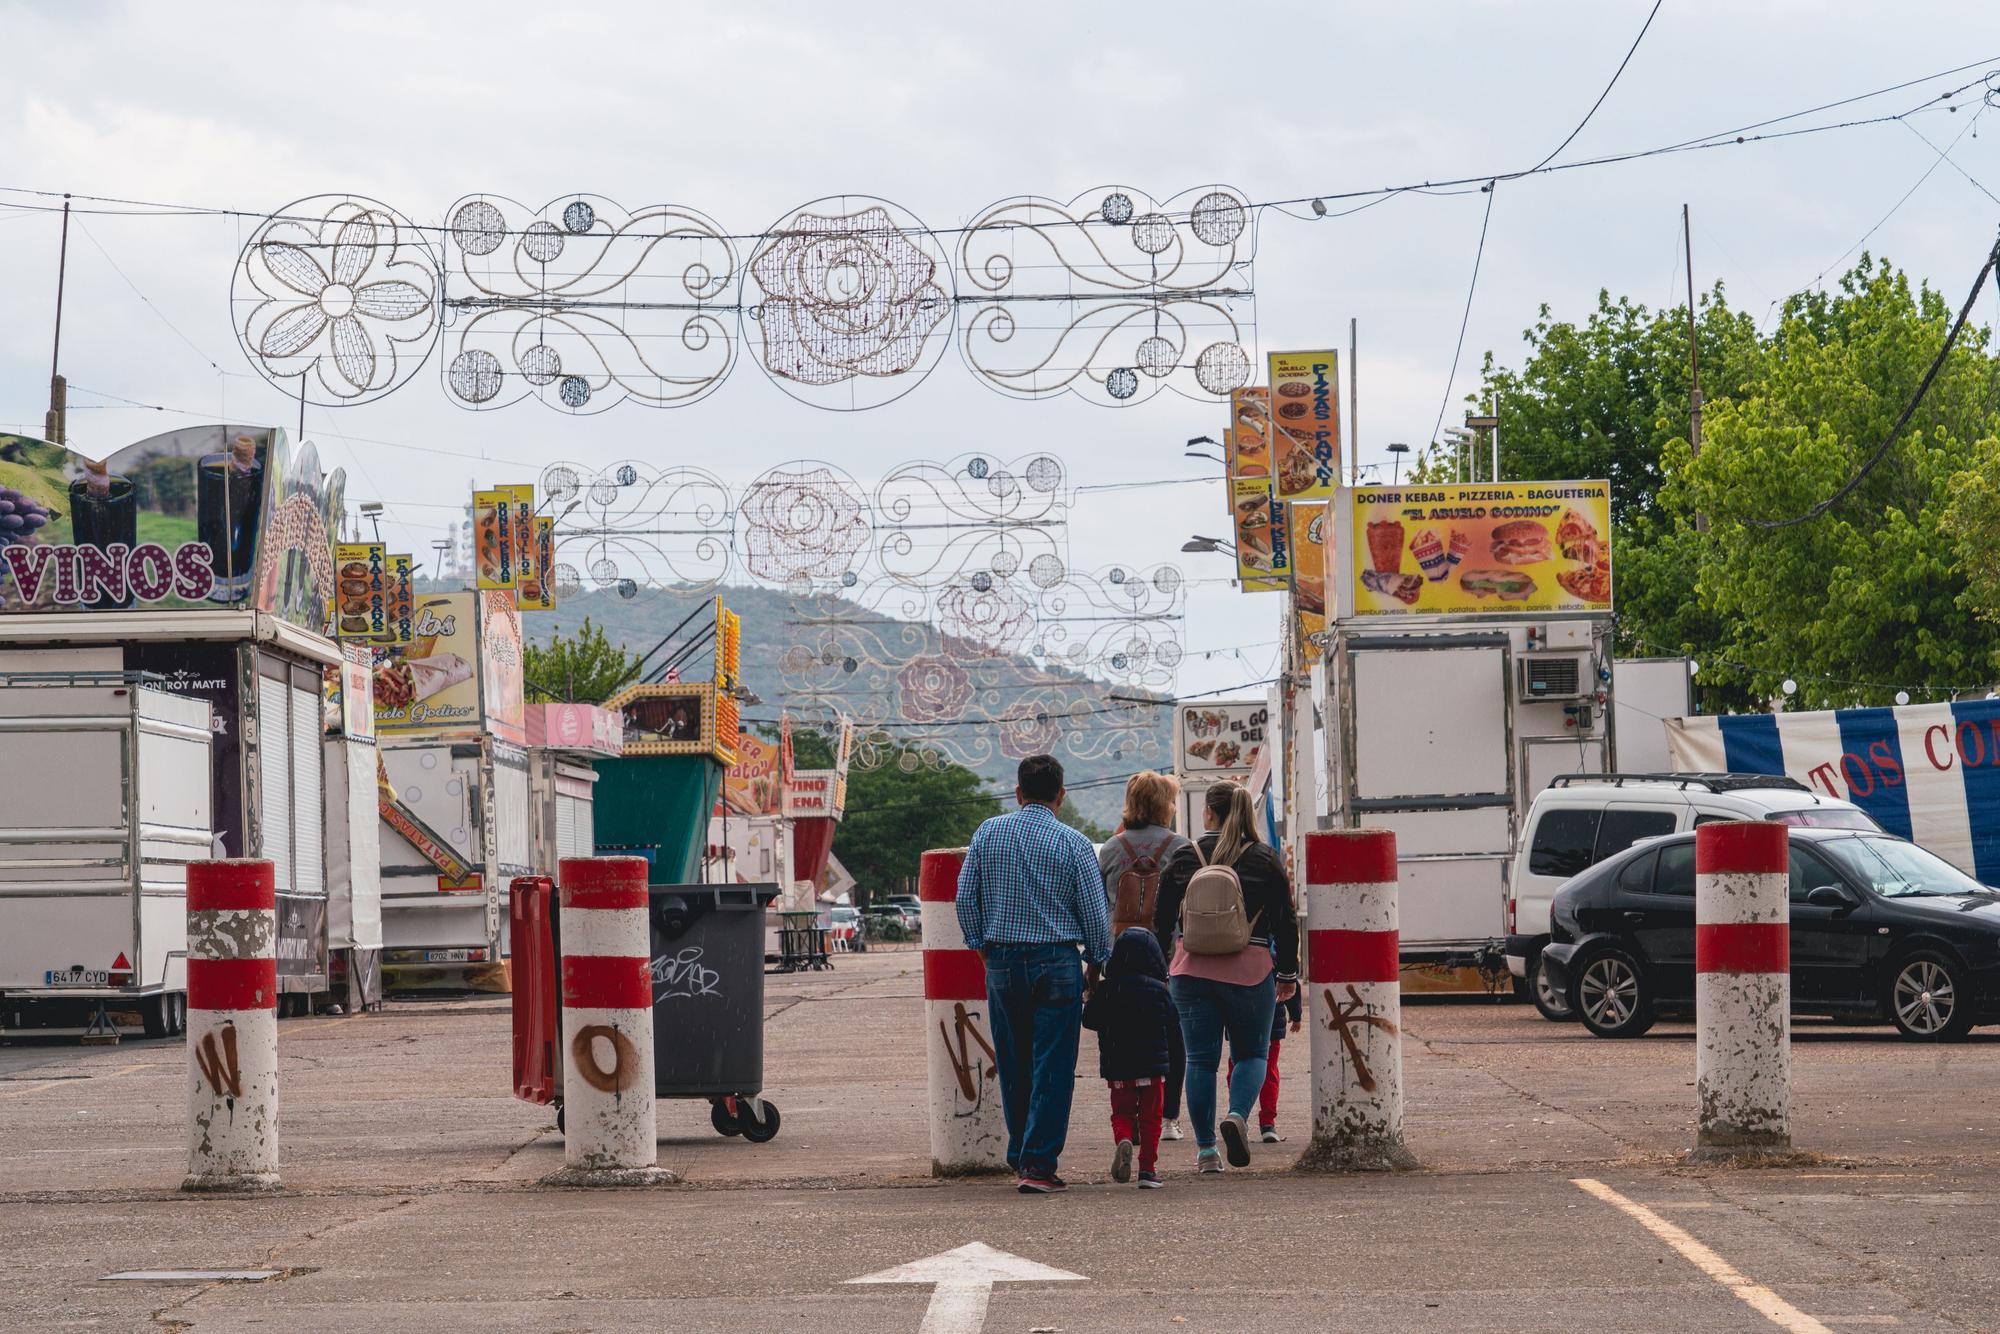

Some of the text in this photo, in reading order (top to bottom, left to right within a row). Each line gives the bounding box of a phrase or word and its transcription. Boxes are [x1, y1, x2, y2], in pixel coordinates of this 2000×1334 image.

[1312, 363, 1330, 420] PIZZAS
[1315, 431, 1333, 487] PANINI
[1357, 494, 1402, 504] DONER
[1405, 492, 1446, 502] KEBAB
[1459, 490, 1515, 501] PIZZERIA
[1527, 488, 1605, 499] BAGUETERIA
[1428, 507, 1486, 520] ABUELO
[1270, 528, 1287, 568] KEBAB
[1, 543, 215, 604] VINOS
[369, 546, 384, 632] PATATAS ASADAS
[1448, 606, 1477, 614] patatas
[192, 680, 226, 690] MAYTE
[1230, 720, 1247, 731] EL
[738, 736, 761, 759] ER
[1807, 740, 1903, 799] TOS
[392, 814, 451, 867] PATATAS
[53, 972, 107, 983] 6417 CYD
